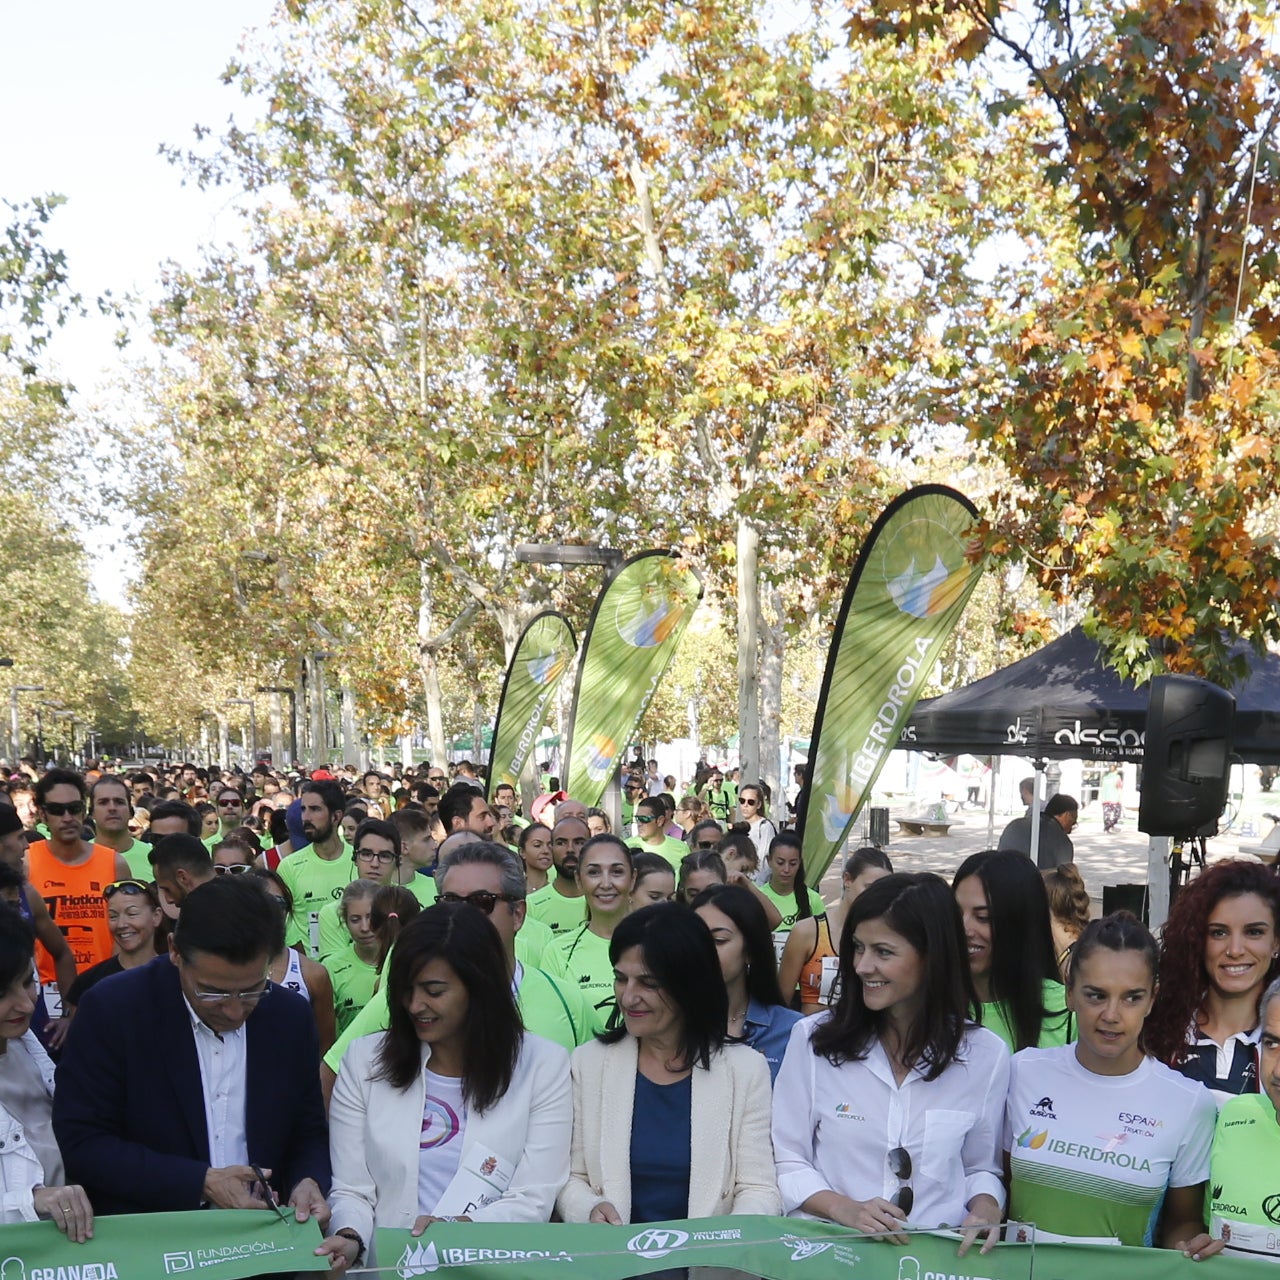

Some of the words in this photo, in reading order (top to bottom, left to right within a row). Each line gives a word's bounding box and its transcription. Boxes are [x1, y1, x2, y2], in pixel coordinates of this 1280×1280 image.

[849, 635, 933, 785] IBERDROLA
[508, 693, 548, 776] IBERDROLA
[1119, 1112, 1163, 1128] ESPAÑA
[1047, 1139, 1151, 1173] IBERDROLA
[197, 1241, 275, 1259] FUNDACIÓN
